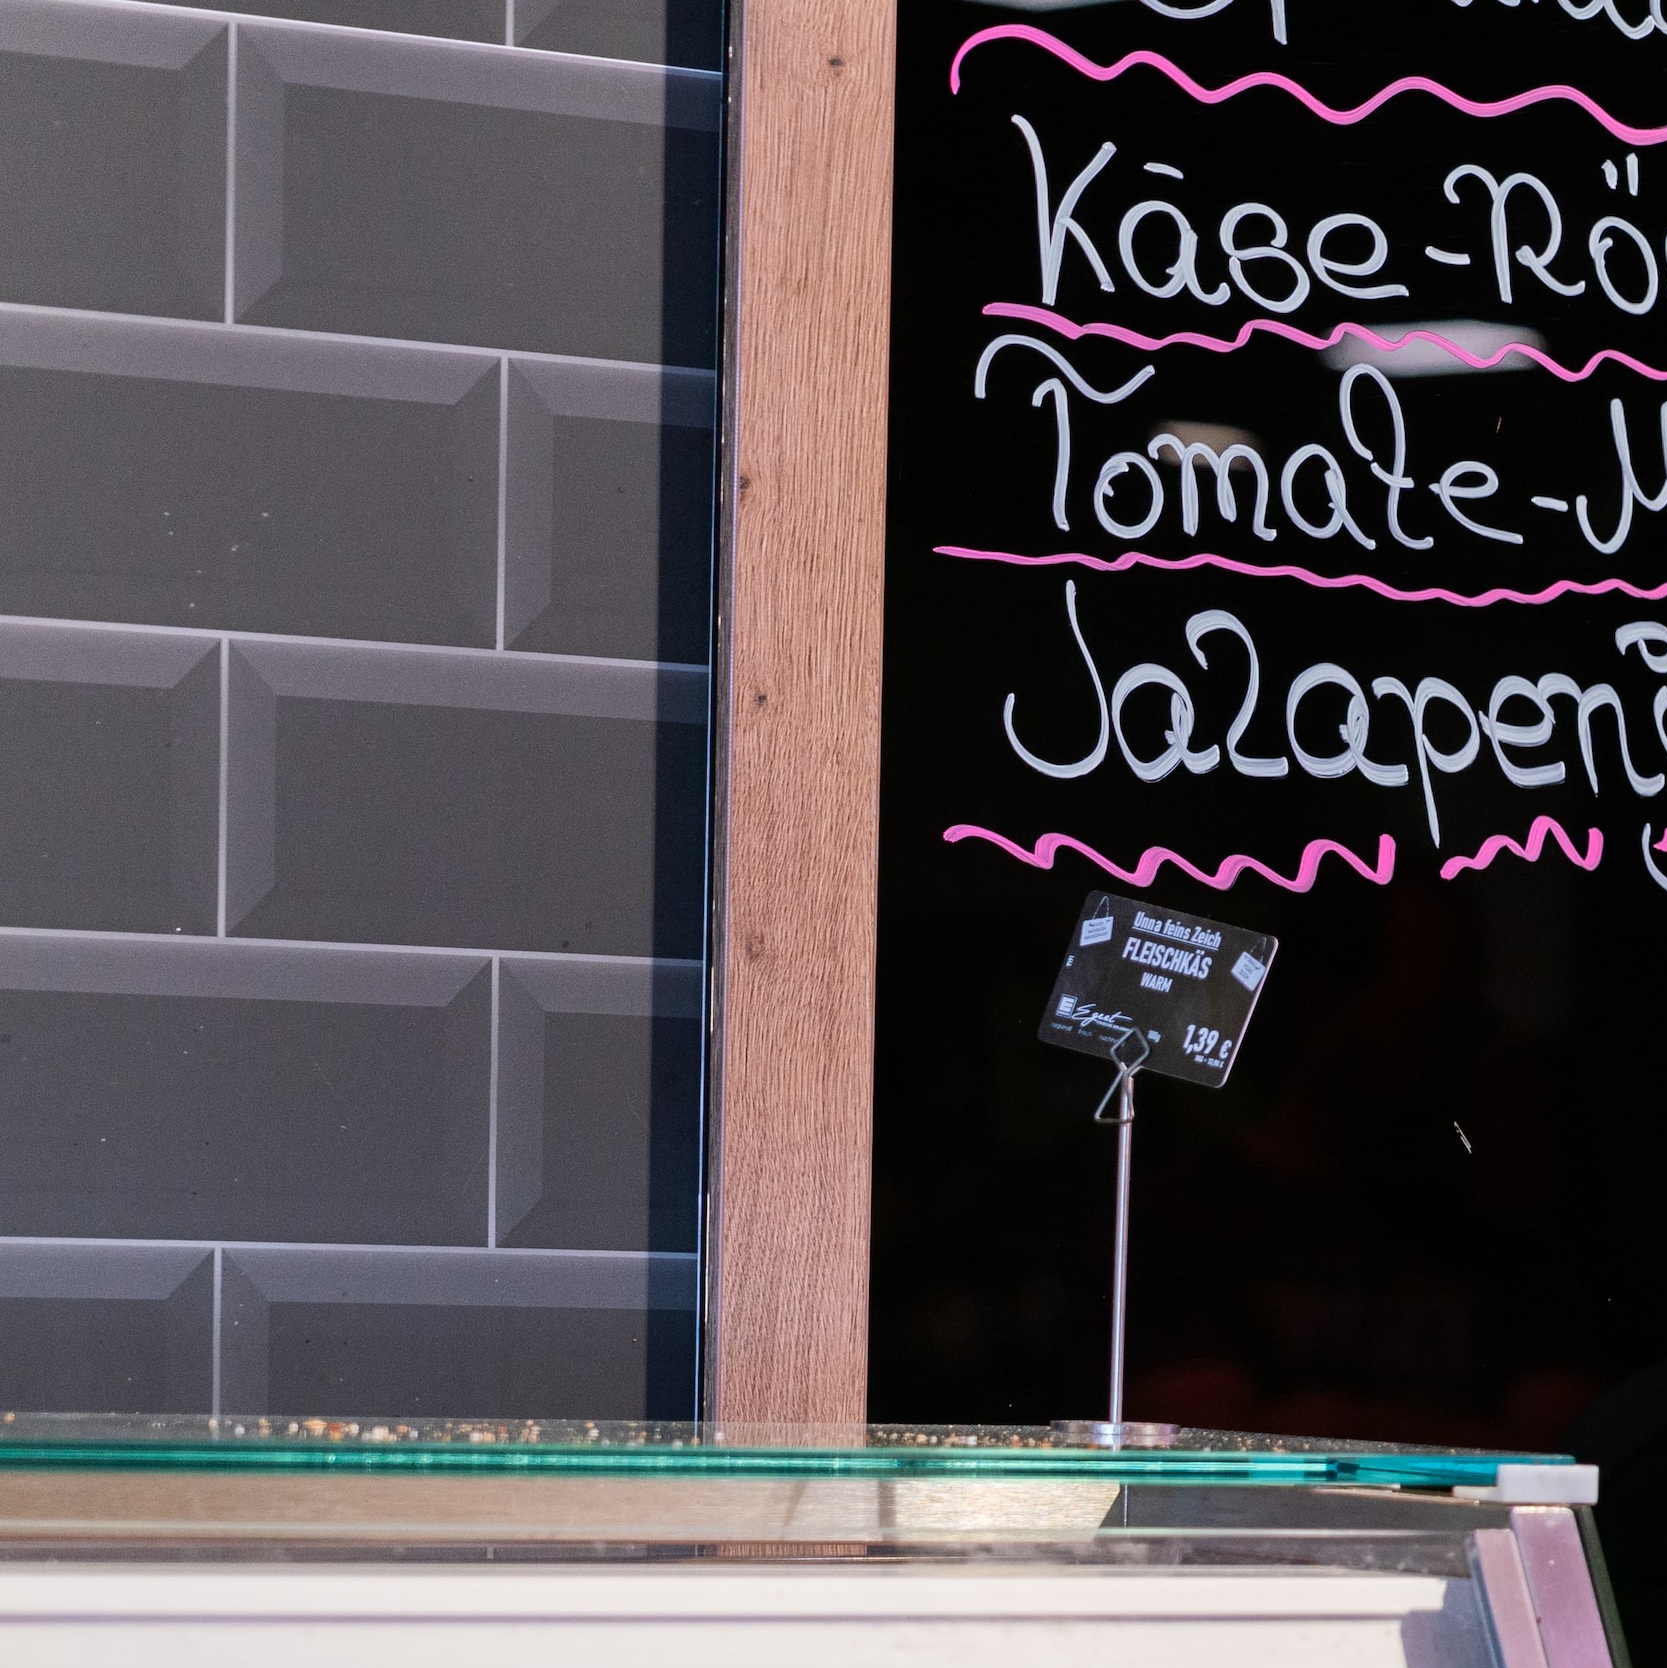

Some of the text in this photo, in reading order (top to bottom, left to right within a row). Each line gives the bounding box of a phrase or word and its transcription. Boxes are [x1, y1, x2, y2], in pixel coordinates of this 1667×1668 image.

[1133, 911, 1163, 933] Unna
[1163, 919, 1192, 941] feins
[1190, 926, 1222, 949] Zeich
[1122, 937, 1213, 980] FLEISCHKÄS
[1140, 972, 1174, 994] WARM
[1182, 1023, 1233, 1060] 1,39 €
